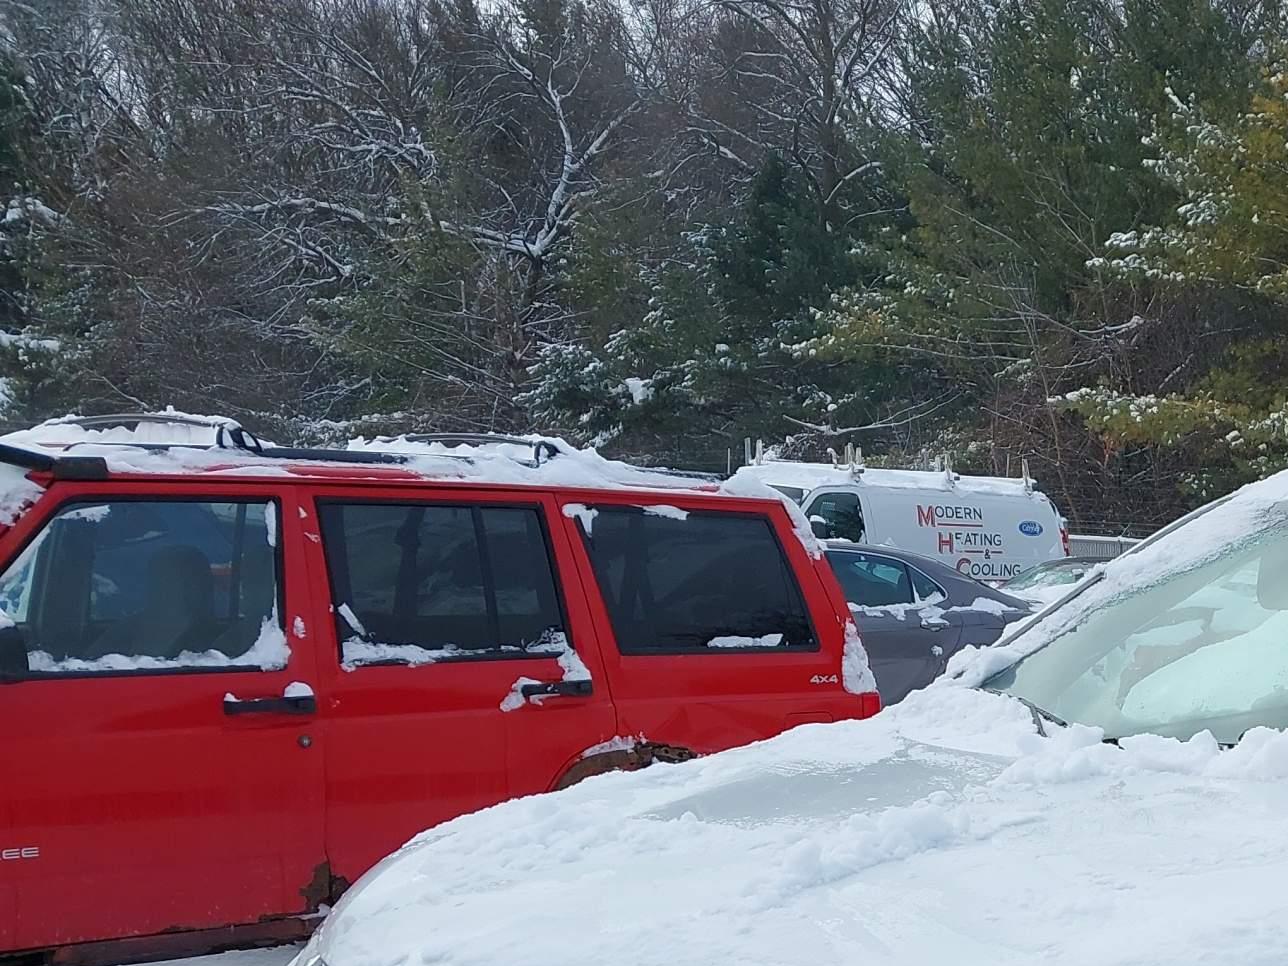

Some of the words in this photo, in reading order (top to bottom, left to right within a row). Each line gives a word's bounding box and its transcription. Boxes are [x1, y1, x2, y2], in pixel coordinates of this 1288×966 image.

[917, 505, 982, 527] MODERN
[938, 532, 1002, 554] HEATING
[984, 549, 991, 559] &
[956, 558, 1021, 576] COOLING
[0, 847, 39, 860] EE
